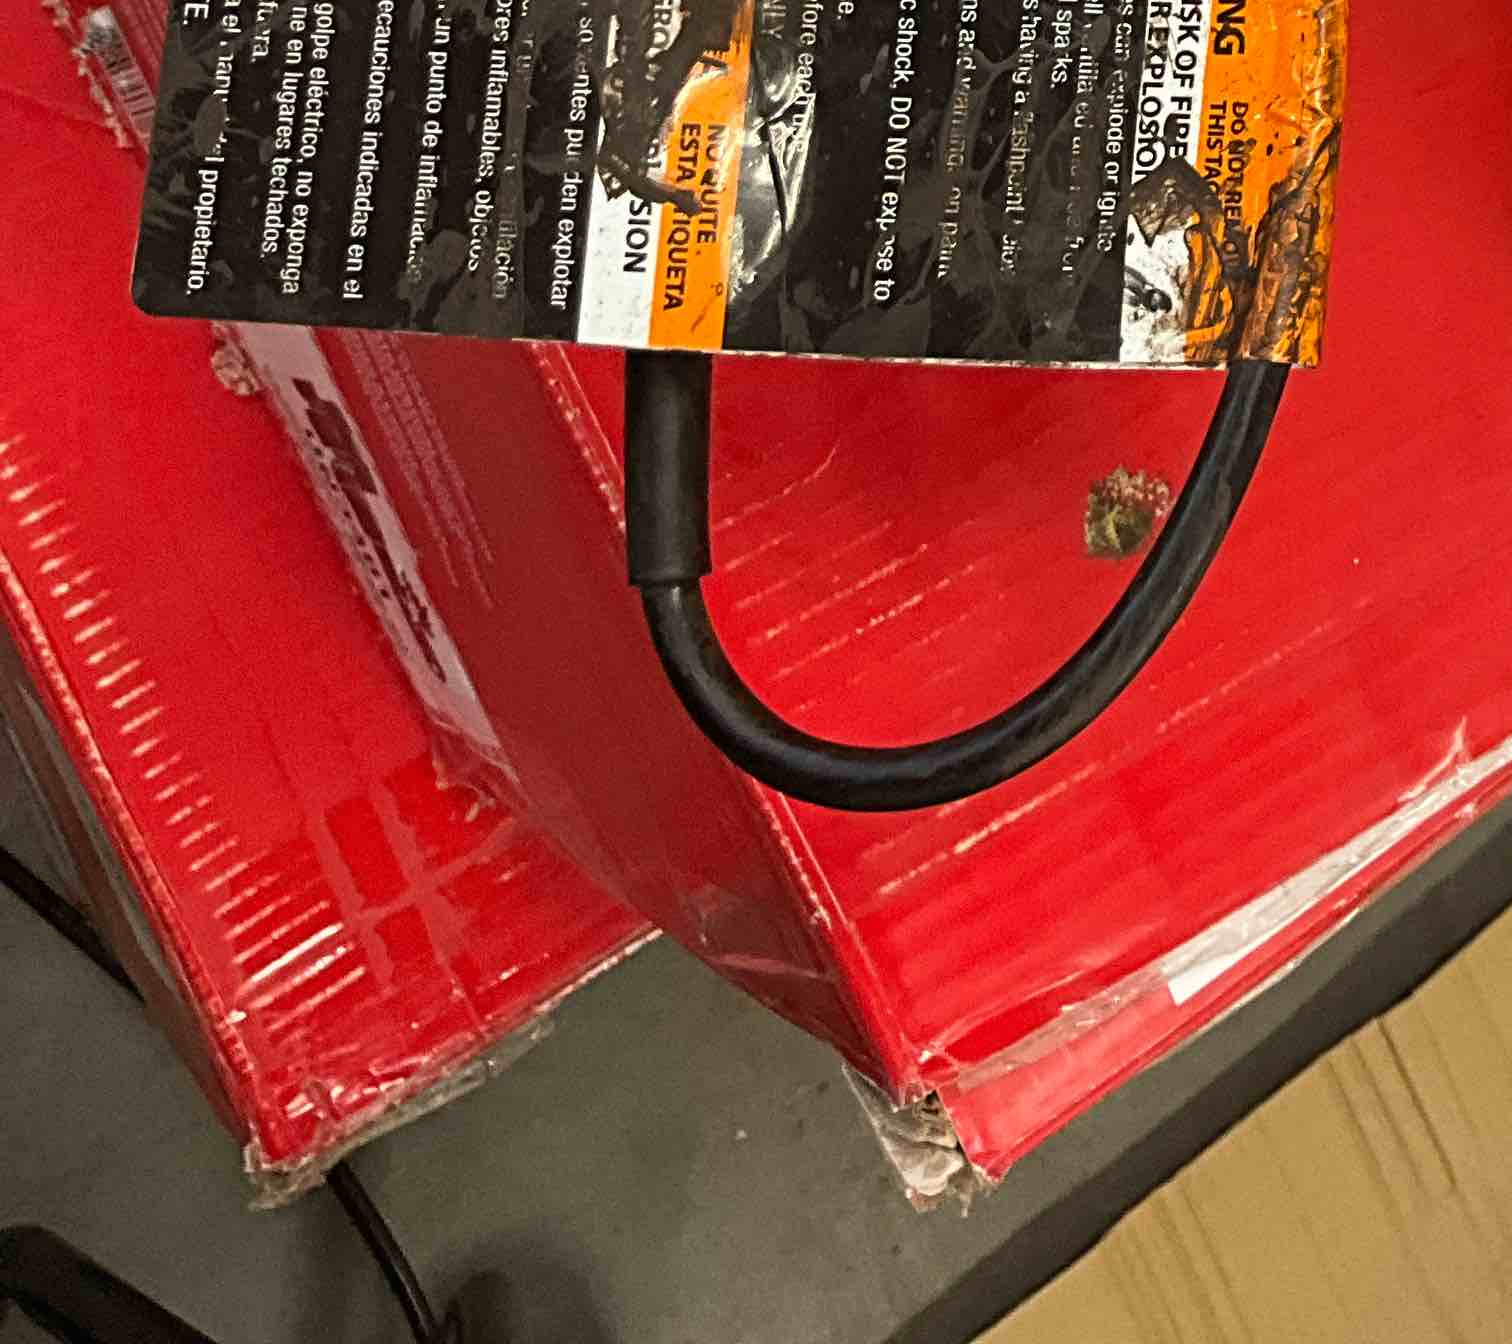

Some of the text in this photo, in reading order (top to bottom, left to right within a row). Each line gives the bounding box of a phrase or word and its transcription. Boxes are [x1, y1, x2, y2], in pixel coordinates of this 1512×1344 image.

[220, 15, 242, 32] el
[307, 2, 338, 59] golpe
[955, 29, 978, 70] and
[1012, 15, 1042, 84] having
[285, 39, 303, 64] en
[888, 17, 918, 90] shock,
[1171, 49, 1197, 88] OF
[422, 51, 451, 114] punto
[793, 53, 818, 105] each
[1015, 90, 1031, 103] a
[270, 72, 303, 149] lugares
[294, 67, 330, 164] eléctrico,
[421, 120, 444, 147] de
[473, 49, 512, 183] inflamables,
[888, 96, 911, 129] DO
[1206, 102, 1227, 150] THIS
[676, 122, 700, 182] ESTA
[883, 137, 907, 183] NOT
[1226, 101, 1249, 189] DO NOT
[294, 171, 312, 197] no
[351, 131, 383, 237] indicadas
[695, 123, 726, 245] NO QUITE
[1101, 161, 1118, 184] or
[260, 157, 293, 259] techados.
[943, 186, 960, 213] on
[181, 169, 220, 295] propietario.
[278, 204, 308, 294] exponga
[346, 244, 365, 271] en
[343, 279, 365, 299] el
[546, 219, 579, 309] explotar
[873, 279, 892, 301] to
